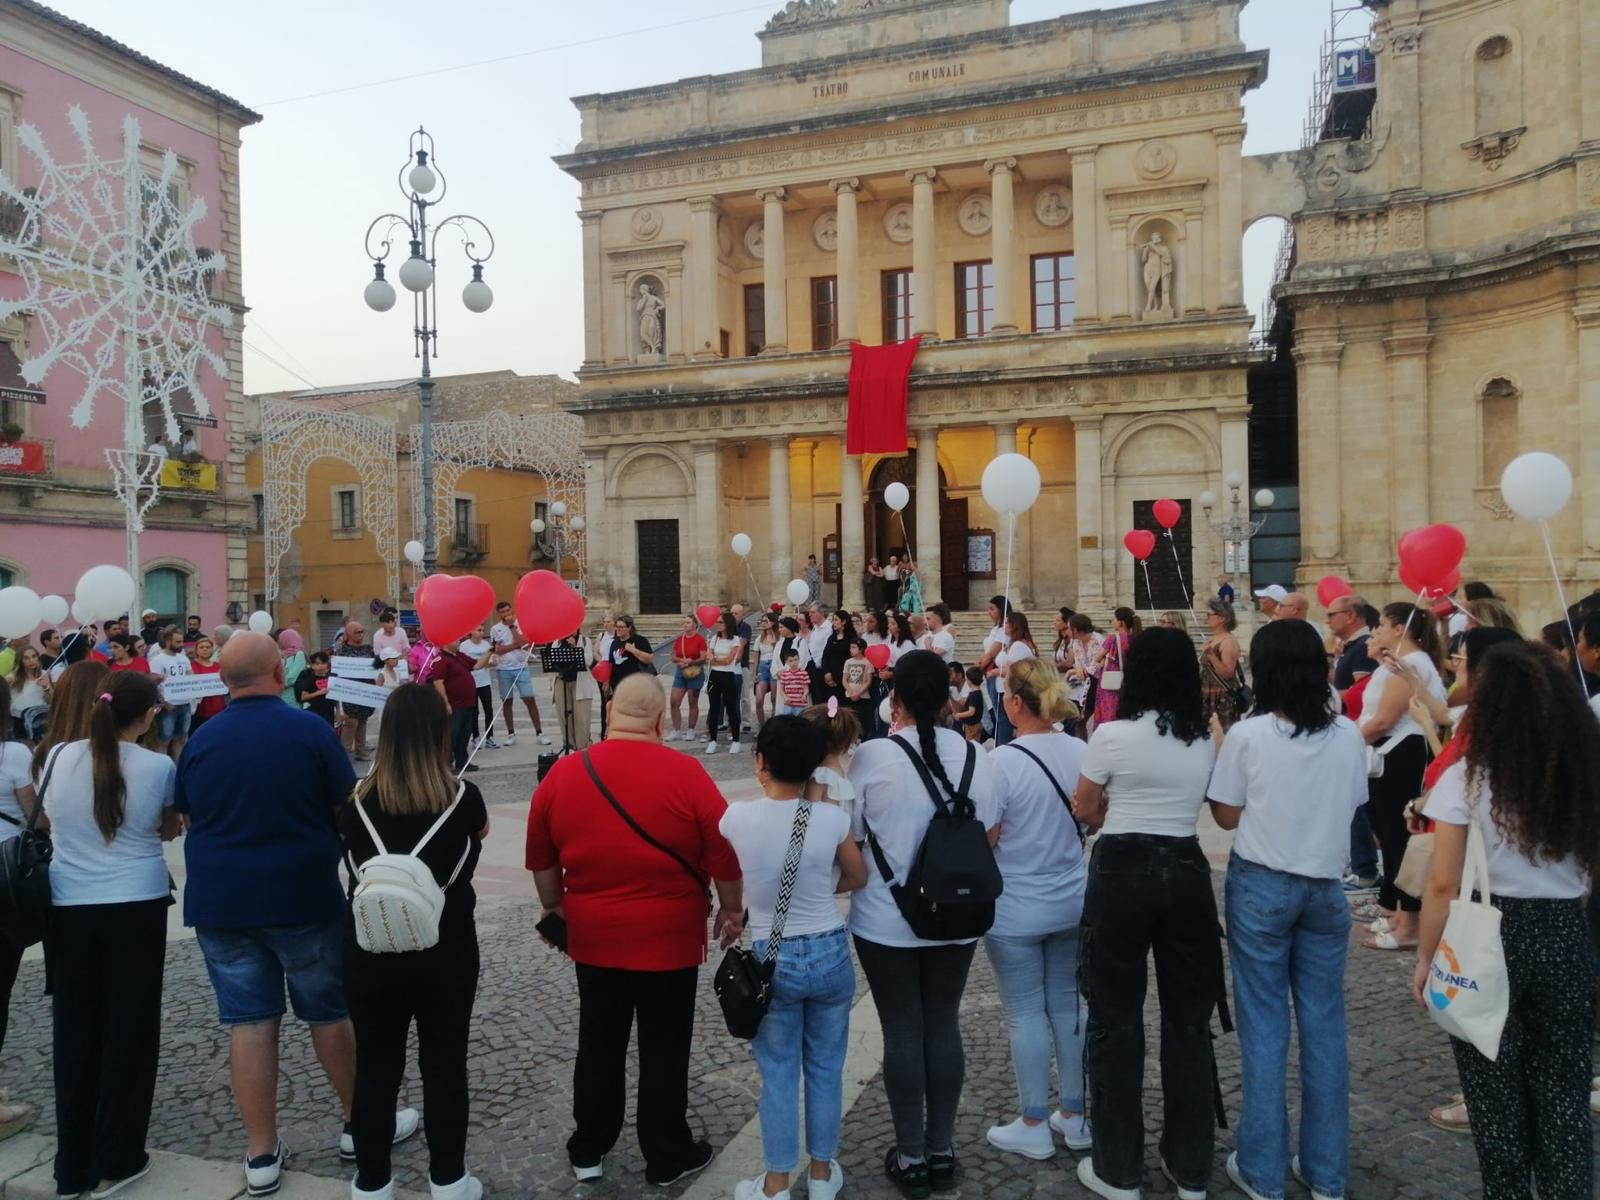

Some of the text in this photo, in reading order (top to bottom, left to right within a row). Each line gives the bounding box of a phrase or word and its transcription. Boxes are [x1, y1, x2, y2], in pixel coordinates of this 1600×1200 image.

[1338, 55, 1359, 75] M
[813, 63, 966, 98] TEATRO COMUNALE
[1, 391, 38, 402] PIZZERIA
